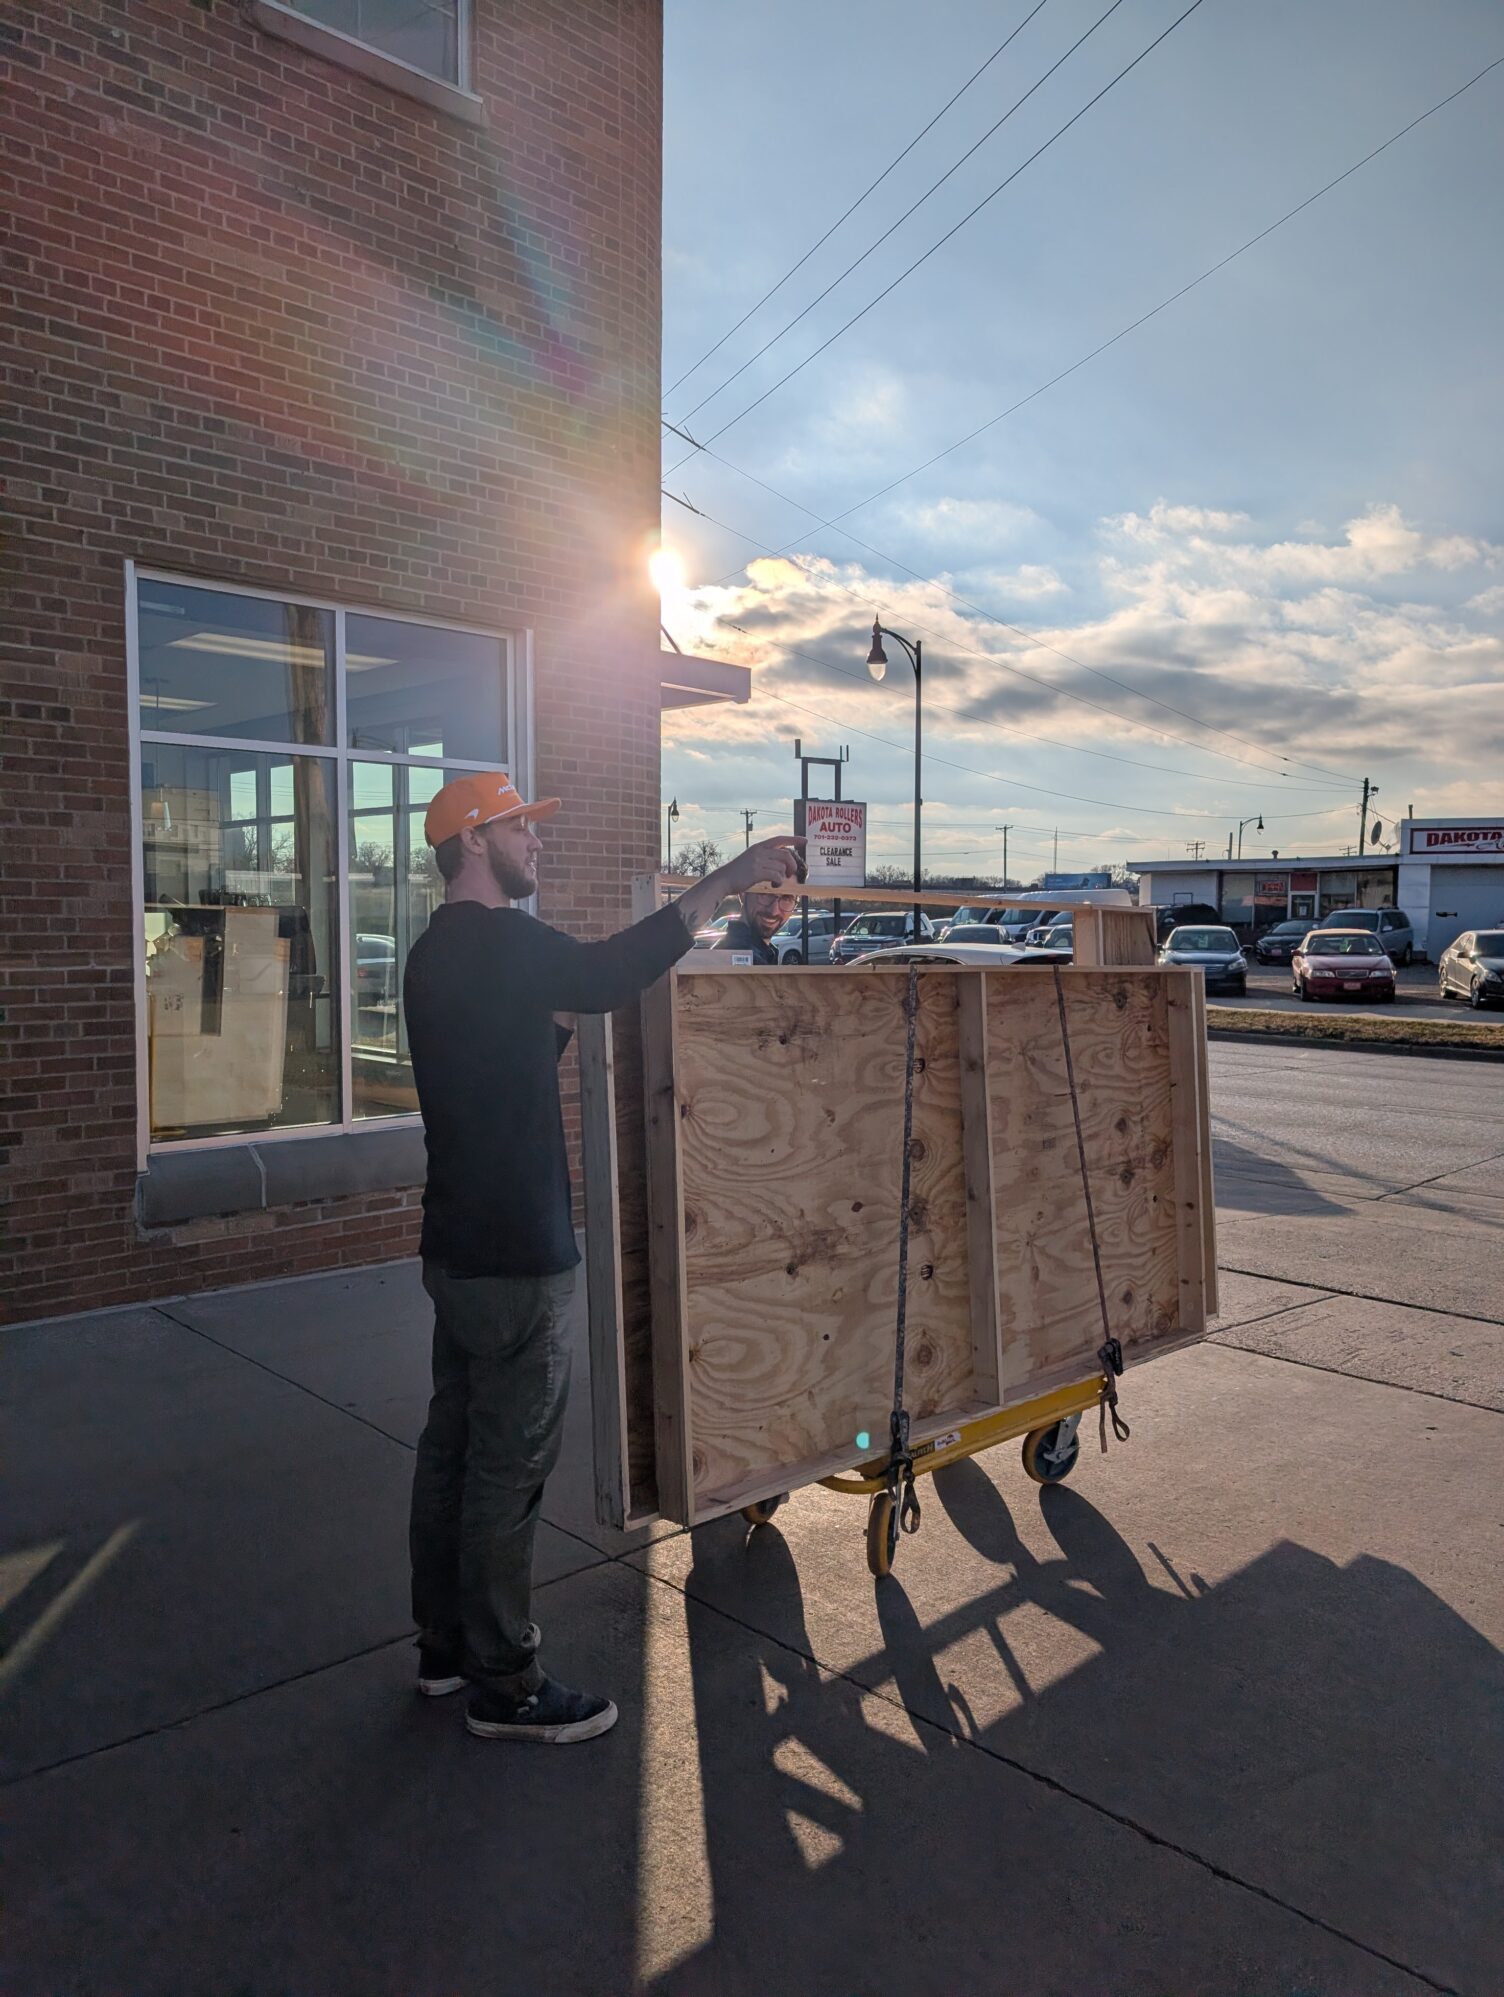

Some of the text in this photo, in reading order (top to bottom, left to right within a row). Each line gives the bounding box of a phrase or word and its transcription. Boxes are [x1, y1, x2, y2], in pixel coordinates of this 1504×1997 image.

[808, 806, 863, 829] DAKOTA ROLLERS
[820, 822, 851, 833] AUTO
[1426, 832, 1502, 848] DAKOTA
[820, 847, 852, 856] CLEARANCE
[826, 858, 841, 866] SALE
